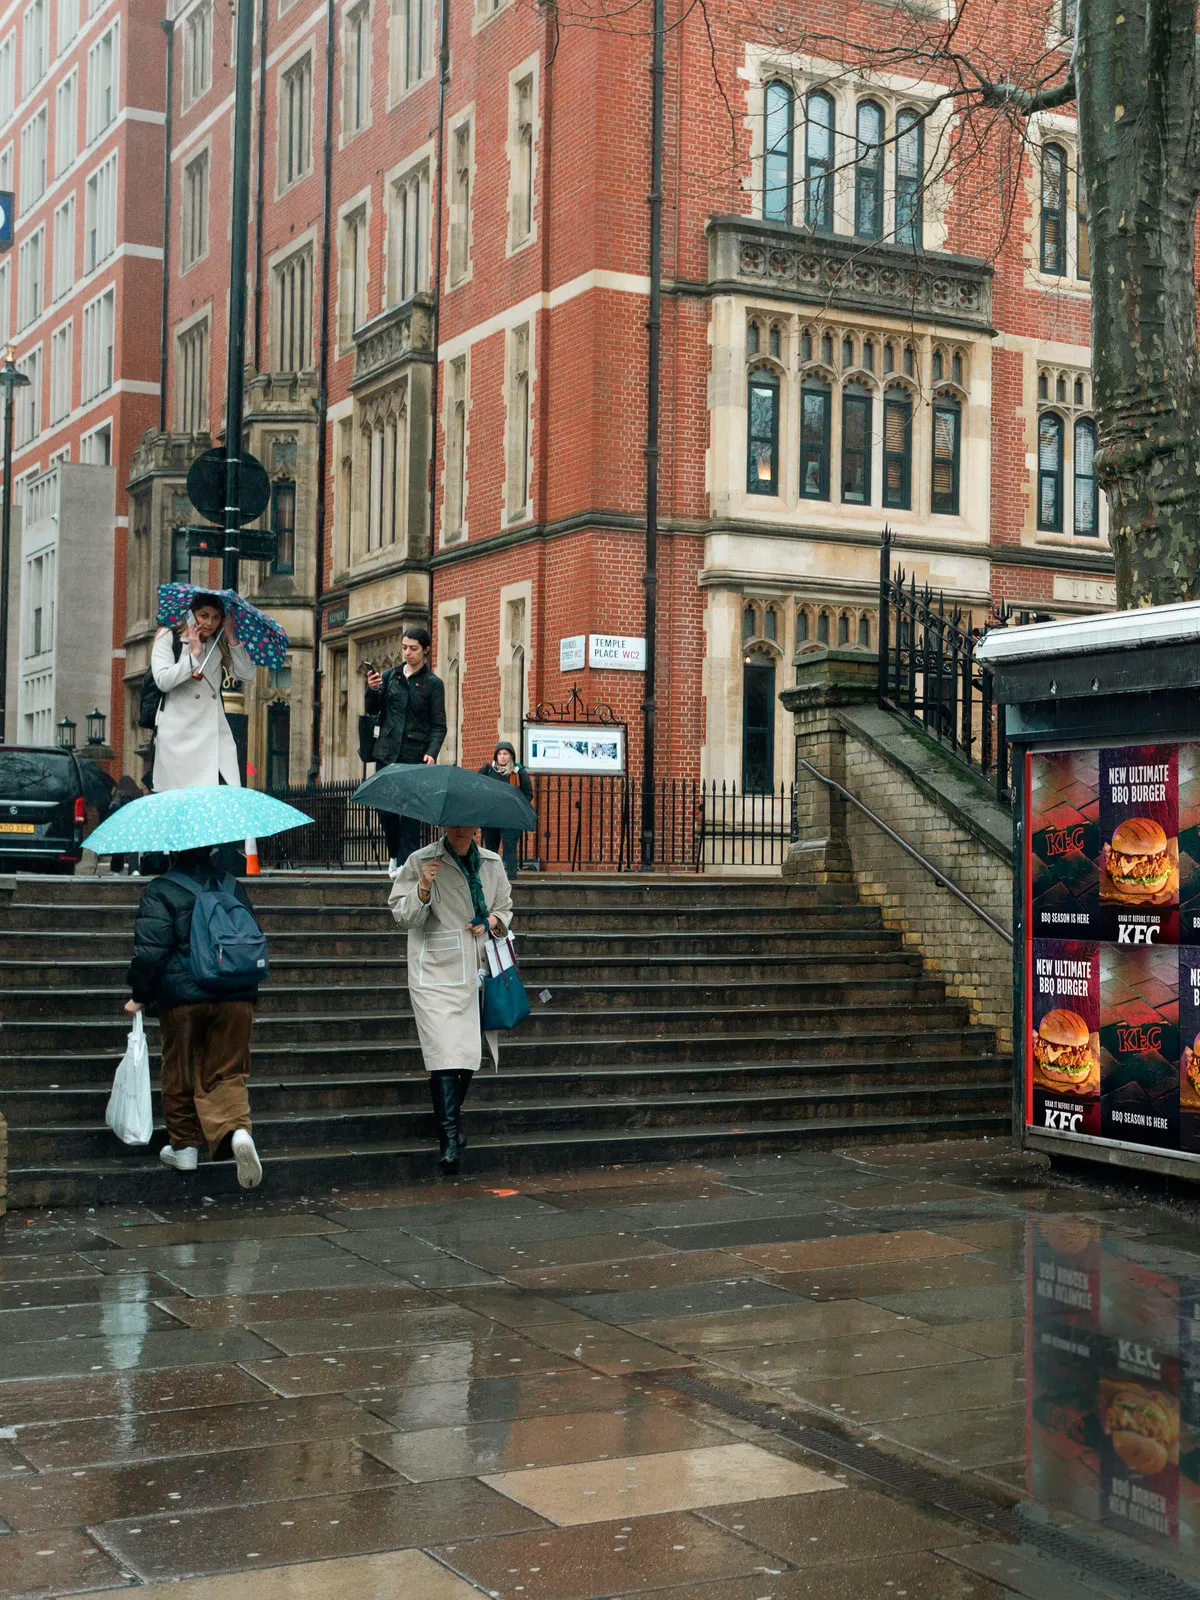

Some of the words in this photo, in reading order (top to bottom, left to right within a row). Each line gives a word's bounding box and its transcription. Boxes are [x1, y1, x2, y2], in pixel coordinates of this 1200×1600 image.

[595, 638, 626, 648] TEMPLE
[594, 649, 618, 658] PLACE
[622, 650, 640, 660] WC2
[1109, 766, 1126, 785] NEW
[1129, 763, 1169, 783] ULTIMATE
[1112, 785, 1128, 806] BBQ
[1131, 783, 1165, 802] BURGER
[1118, 924, 1160, 944] KFC
[1036, 958, 1052, 976] NEW
[1055, 959, 1091, 978] ULTIMATE
[1039, 976, 1054, 996] BBQ
[1057, 978, 1088, 997] BURGER
[1044, 1109, 1083, 1132] KFC
[1112, 1110, 1123, 1123] BBQ
[1124, 1112, 1145, 1126] SEASON
[1146, 1115, 1152, 1127] IS
[1153, 1117, 1167, 1129] HERE
